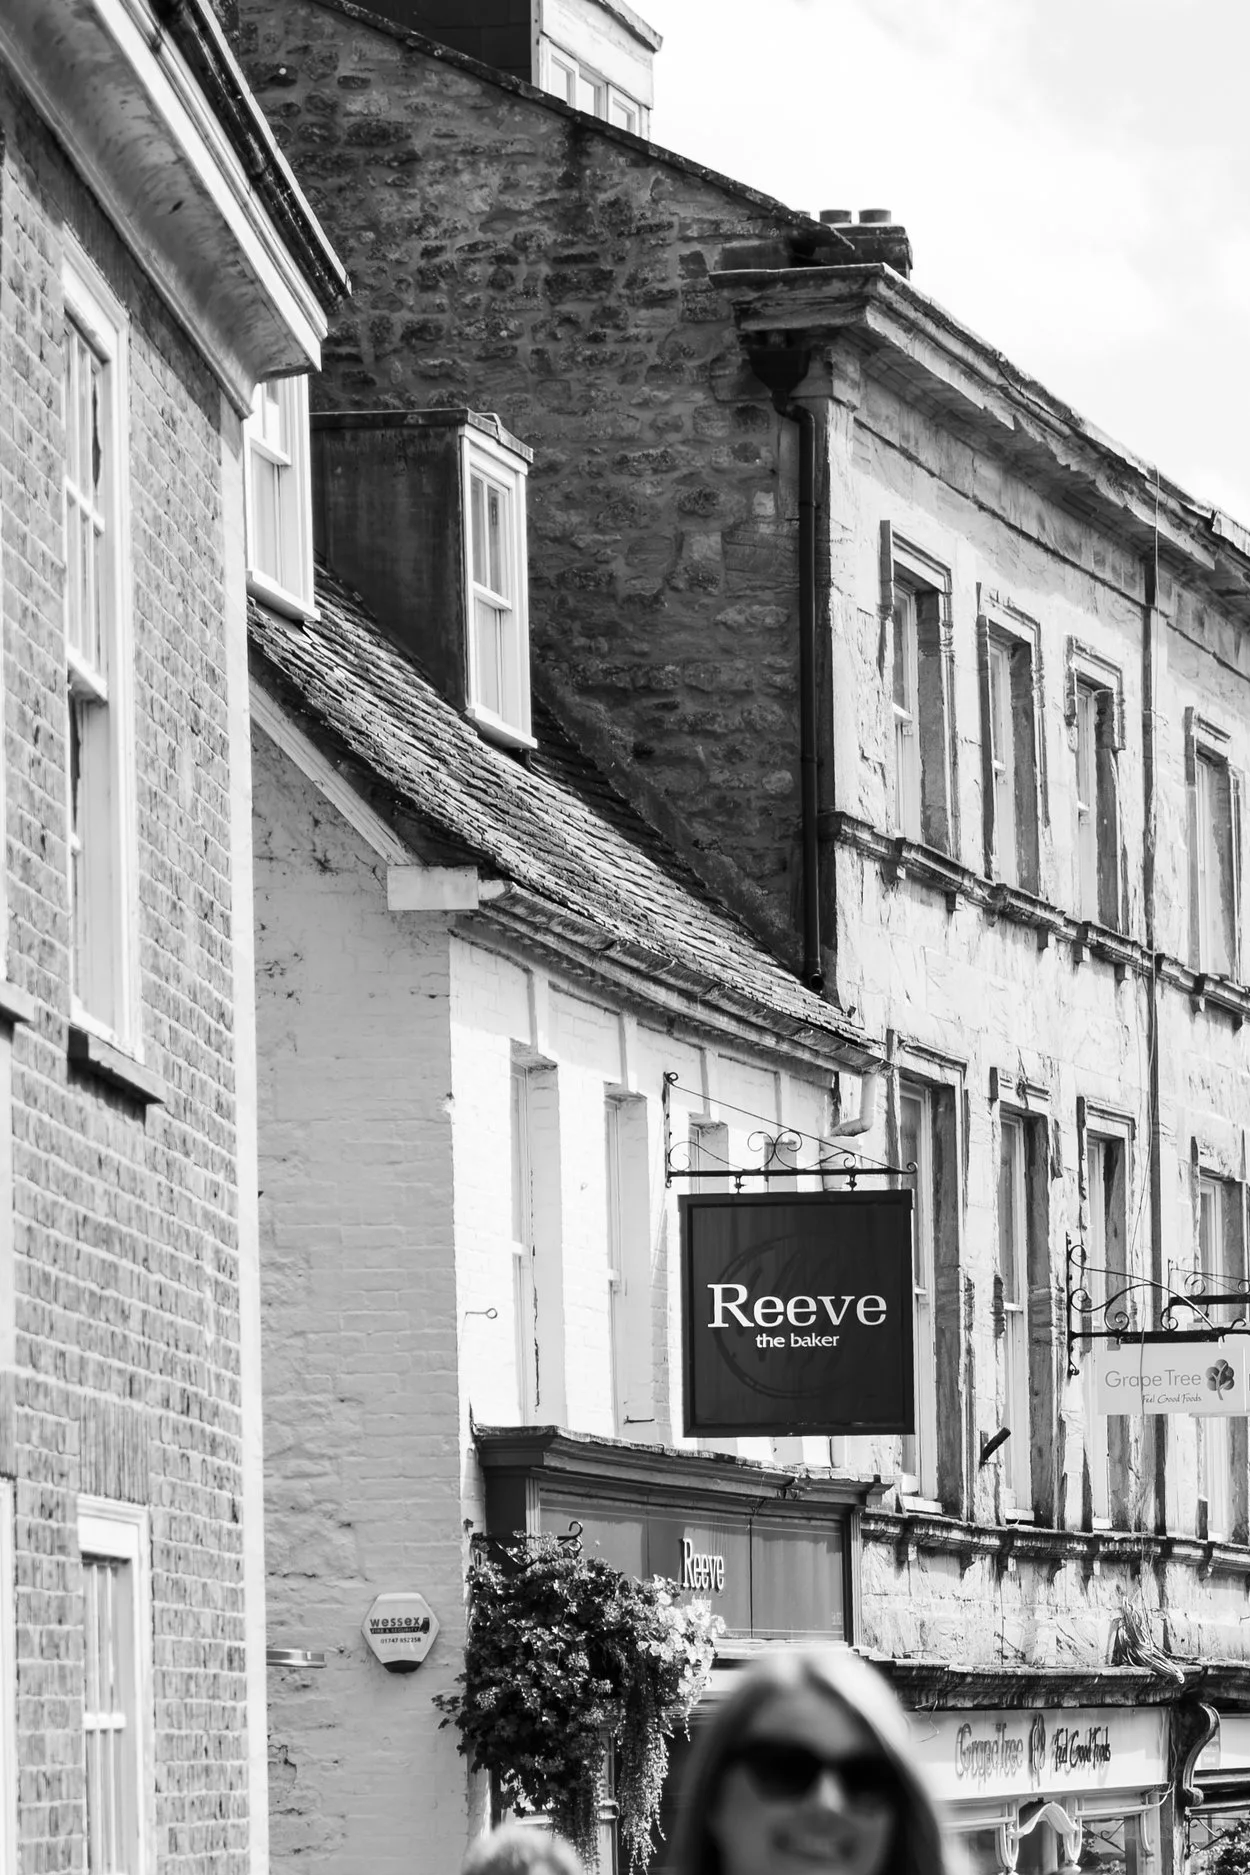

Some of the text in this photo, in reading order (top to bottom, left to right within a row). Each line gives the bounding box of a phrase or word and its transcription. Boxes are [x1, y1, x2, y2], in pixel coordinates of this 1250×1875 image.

[707, 1283, 887, 1328] Reeve
[755, 1332, 840, 1348] the baker
[1105, 1368, 1201, 1390] Grape Tree
[1142, 1392, 1202, 1404] Feel Good Foods
[683, 1538, 725, 1590] Reeve
[370, 1617, 420, 1627] wessex
